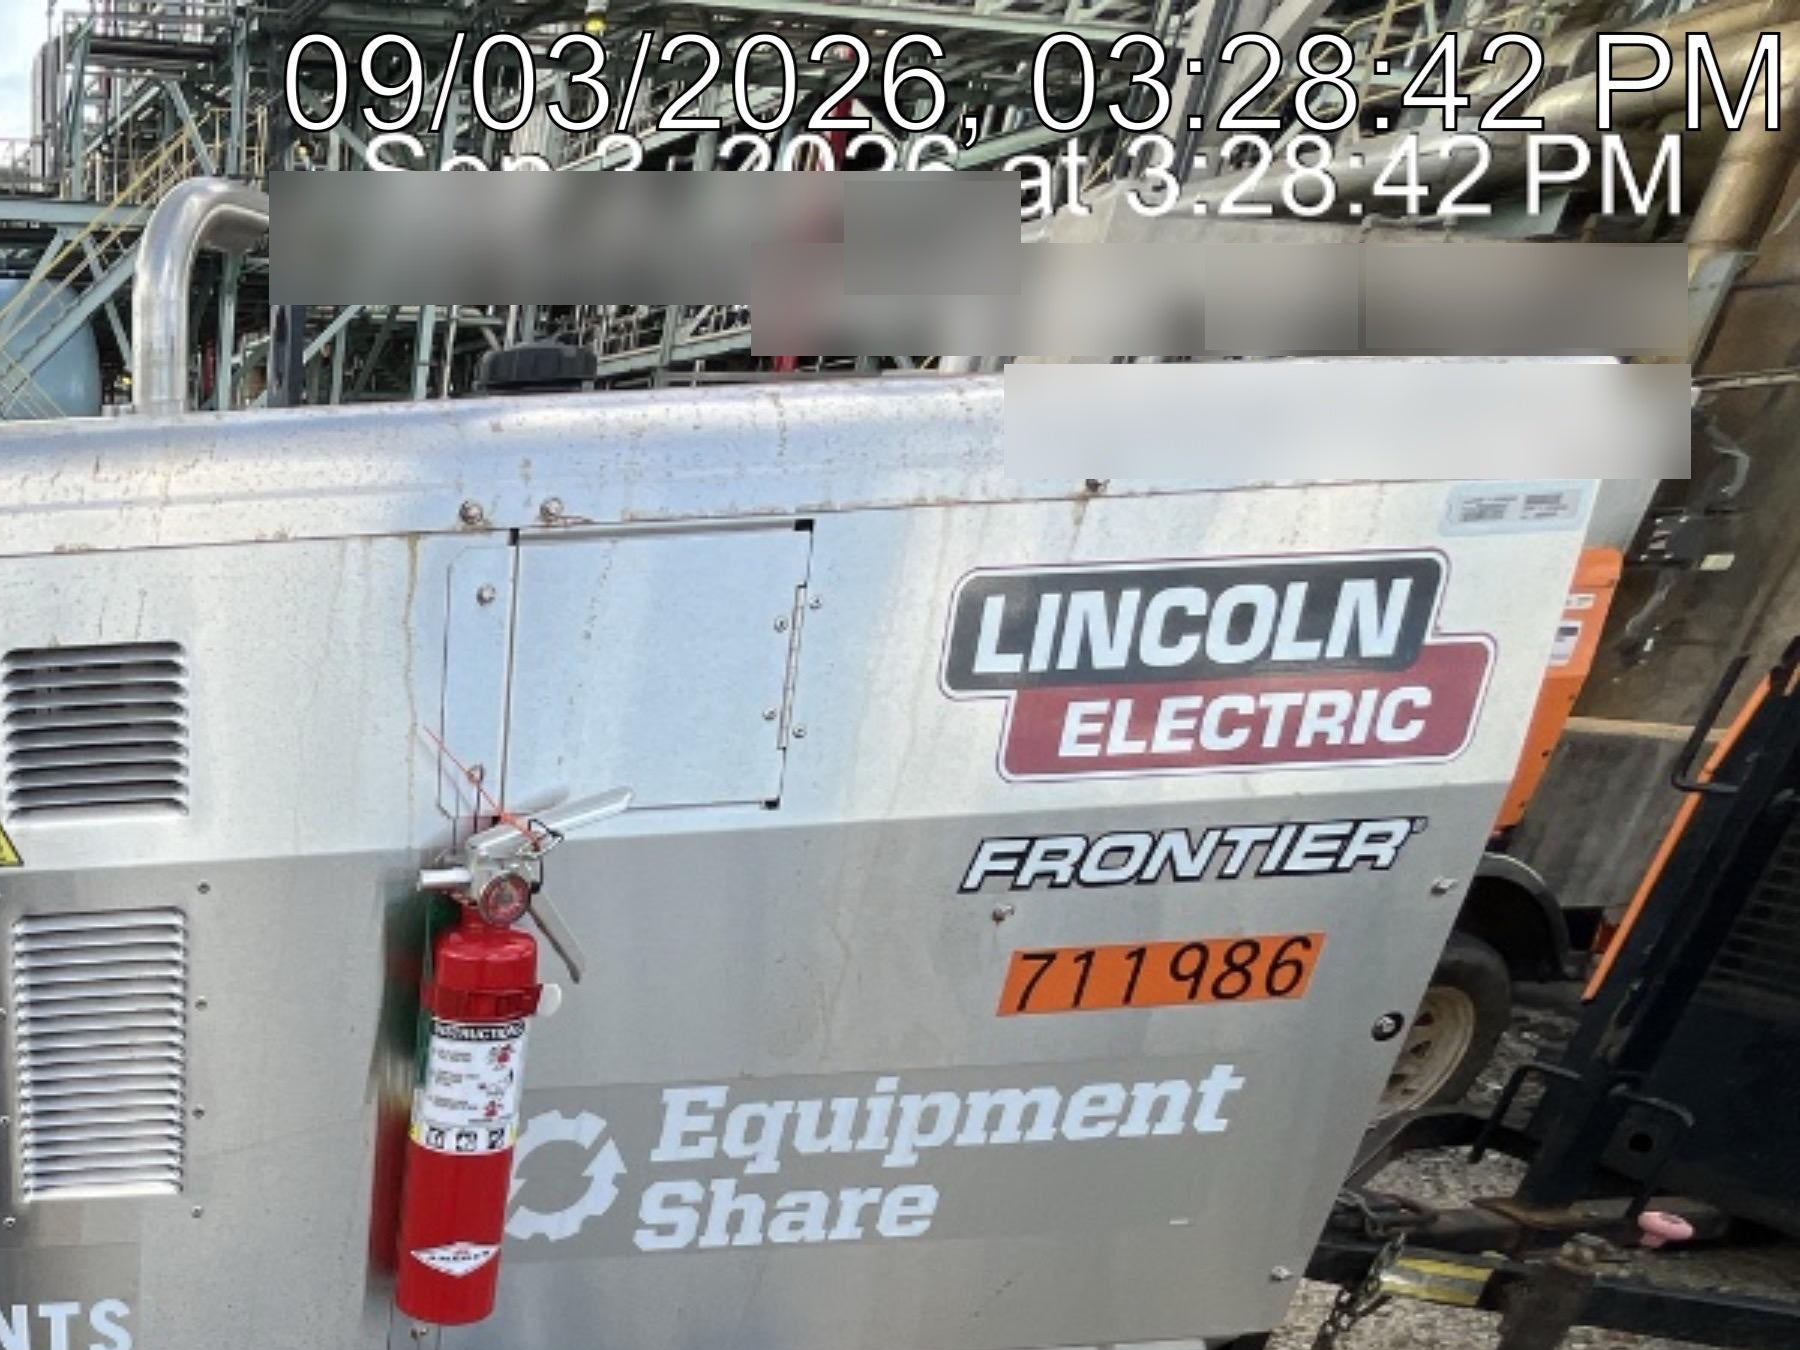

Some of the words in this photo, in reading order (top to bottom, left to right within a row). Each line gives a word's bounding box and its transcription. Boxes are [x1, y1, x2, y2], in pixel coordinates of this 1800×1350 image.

[972, 578, 1413, 675] LINCOLN
[1058, 686, 1431, 758] ELECTRIC
[1017, 934, 1314, 1013] 711986
[651, 1064, 1243, 1169] Equipment
[634, 1182, 939, 1252] Share
